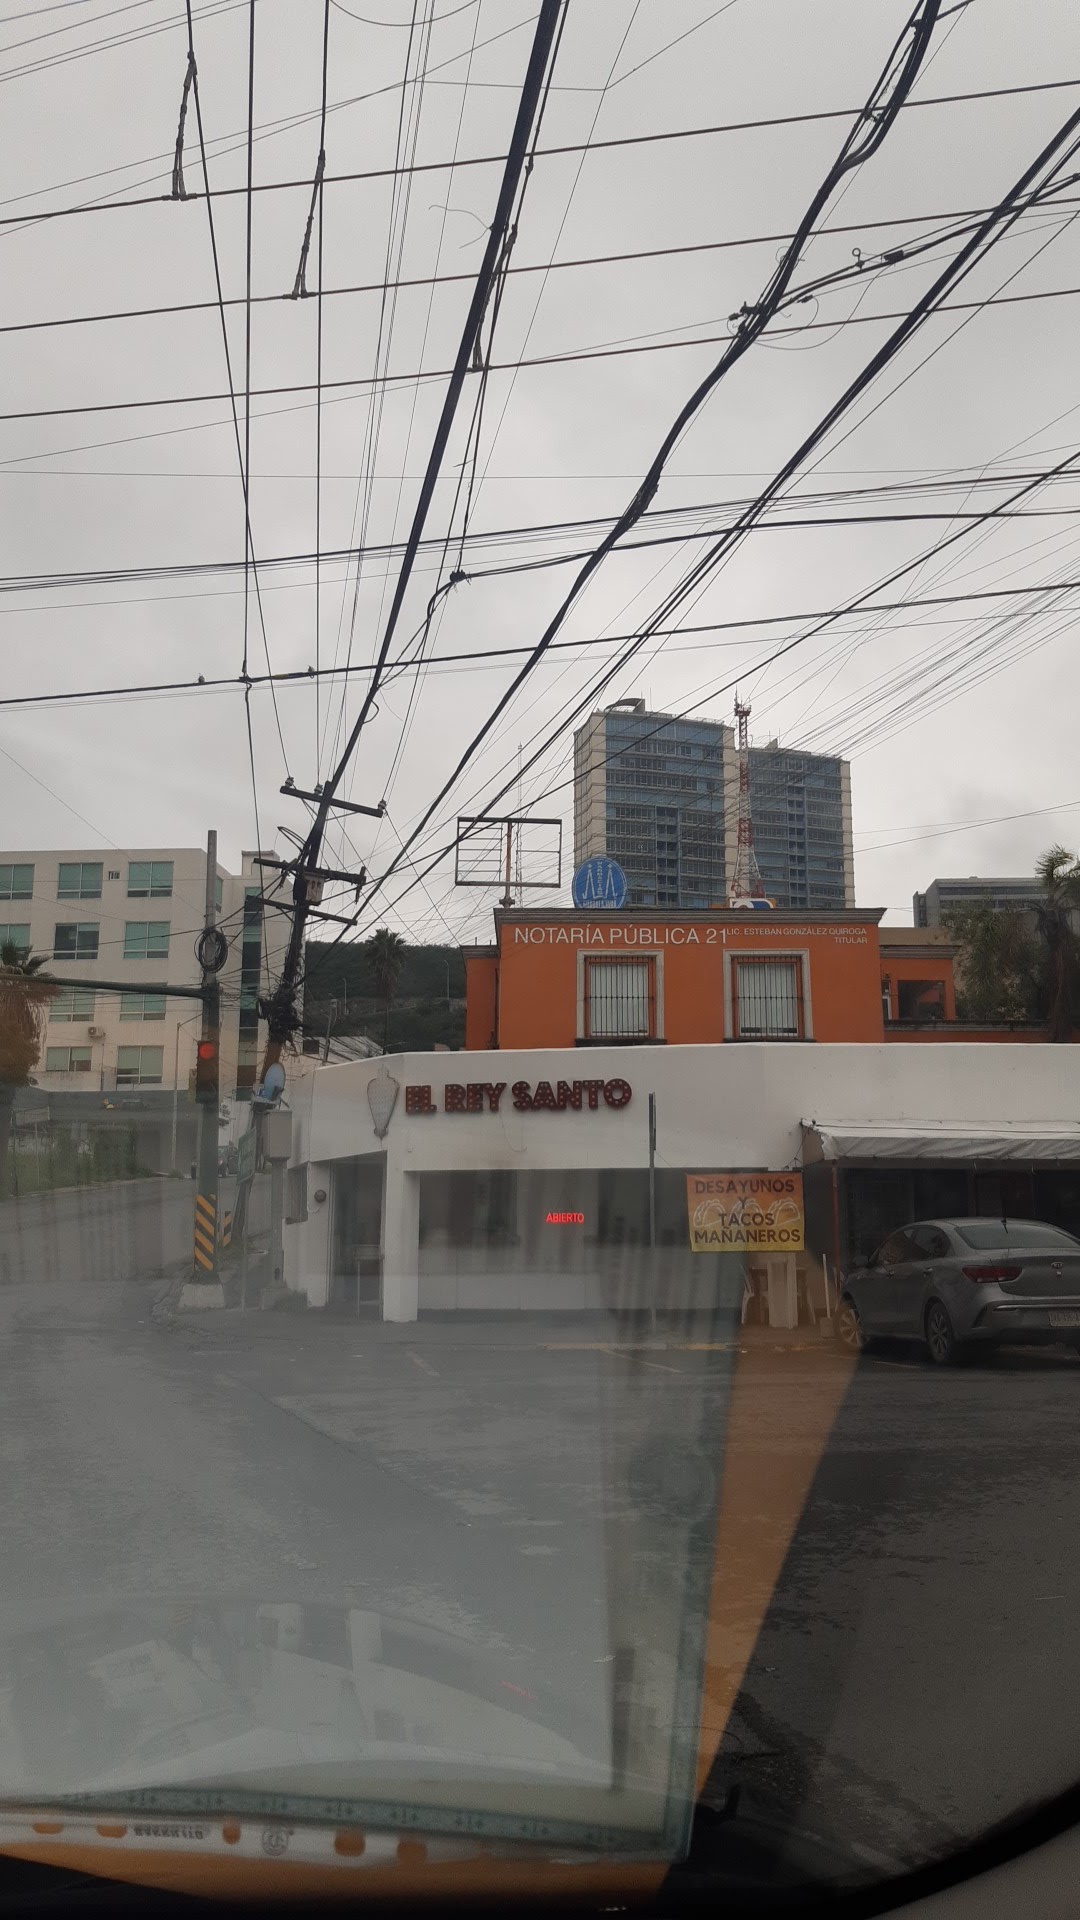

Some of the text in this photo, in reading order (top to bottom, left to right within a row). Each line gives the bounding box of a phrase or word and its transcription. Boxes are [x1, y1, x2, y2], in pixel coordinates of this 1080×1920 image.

[514, 924, 727, 944] NOTARÍA PÚBLICA 21
[727, 926, 867, 936] LIC. ESTEBAN GONZÁLEZ QUIROGA
[405, 1078, 632, 1114] EL REY SANTO
[695, 1180, 795, 1194] DESAYUNOS
[738, 1197, 749, 1209] Y
[545, 1211, 585, 1224] ABIERTO
[718, 1212, 775, 1226] TACOS
[694, 1226, 801, 1243] MAÑANEROS
